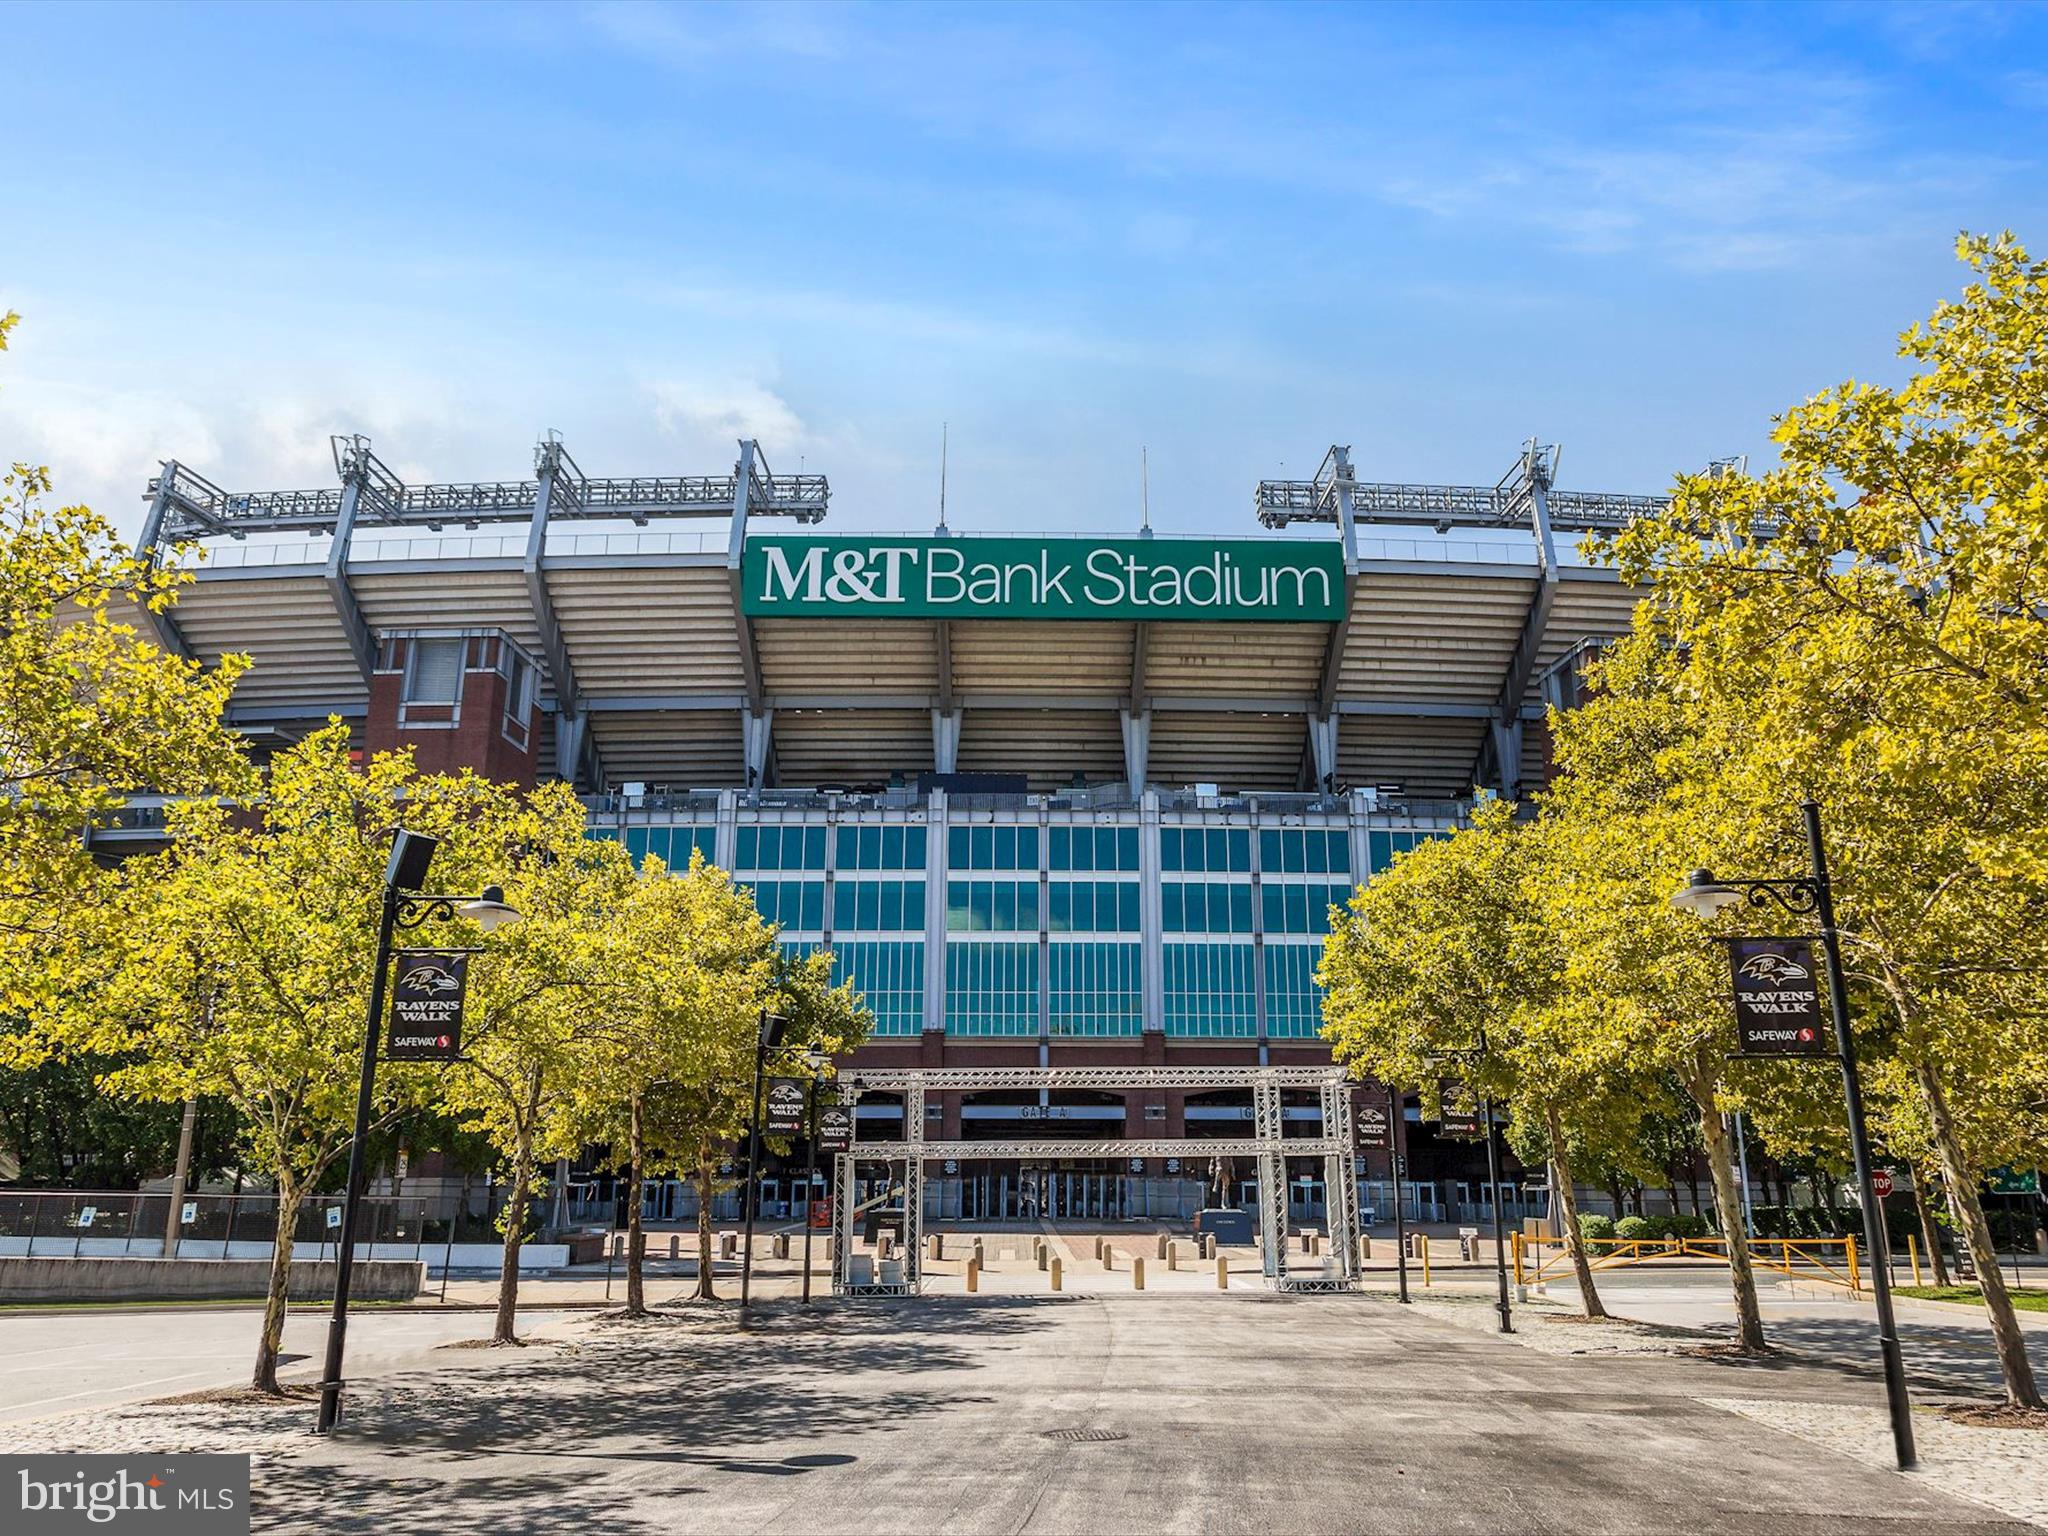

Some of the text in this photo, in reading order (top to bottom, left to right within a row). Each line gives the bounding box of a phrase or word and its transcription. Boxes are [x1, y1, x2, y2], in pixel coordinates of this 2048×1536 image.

[759, 546, 1330, 607] M&T Bank Stadium
[1738, 991, 1816, 1003] RAVENS
[395, 1001, 460, 1011] RAVENS
[1747, 1003, 1810, 1014] WALK
[400, 1011, 452, 1022] WALK
[1748, 1029, 1798, 1041] SAFEWAY
[394, 1036, 437, 1047] SAFEWAY
[1022, 1105, 1051, 1118] GATE
[1872, 1178, 1891, 1189] TOP
